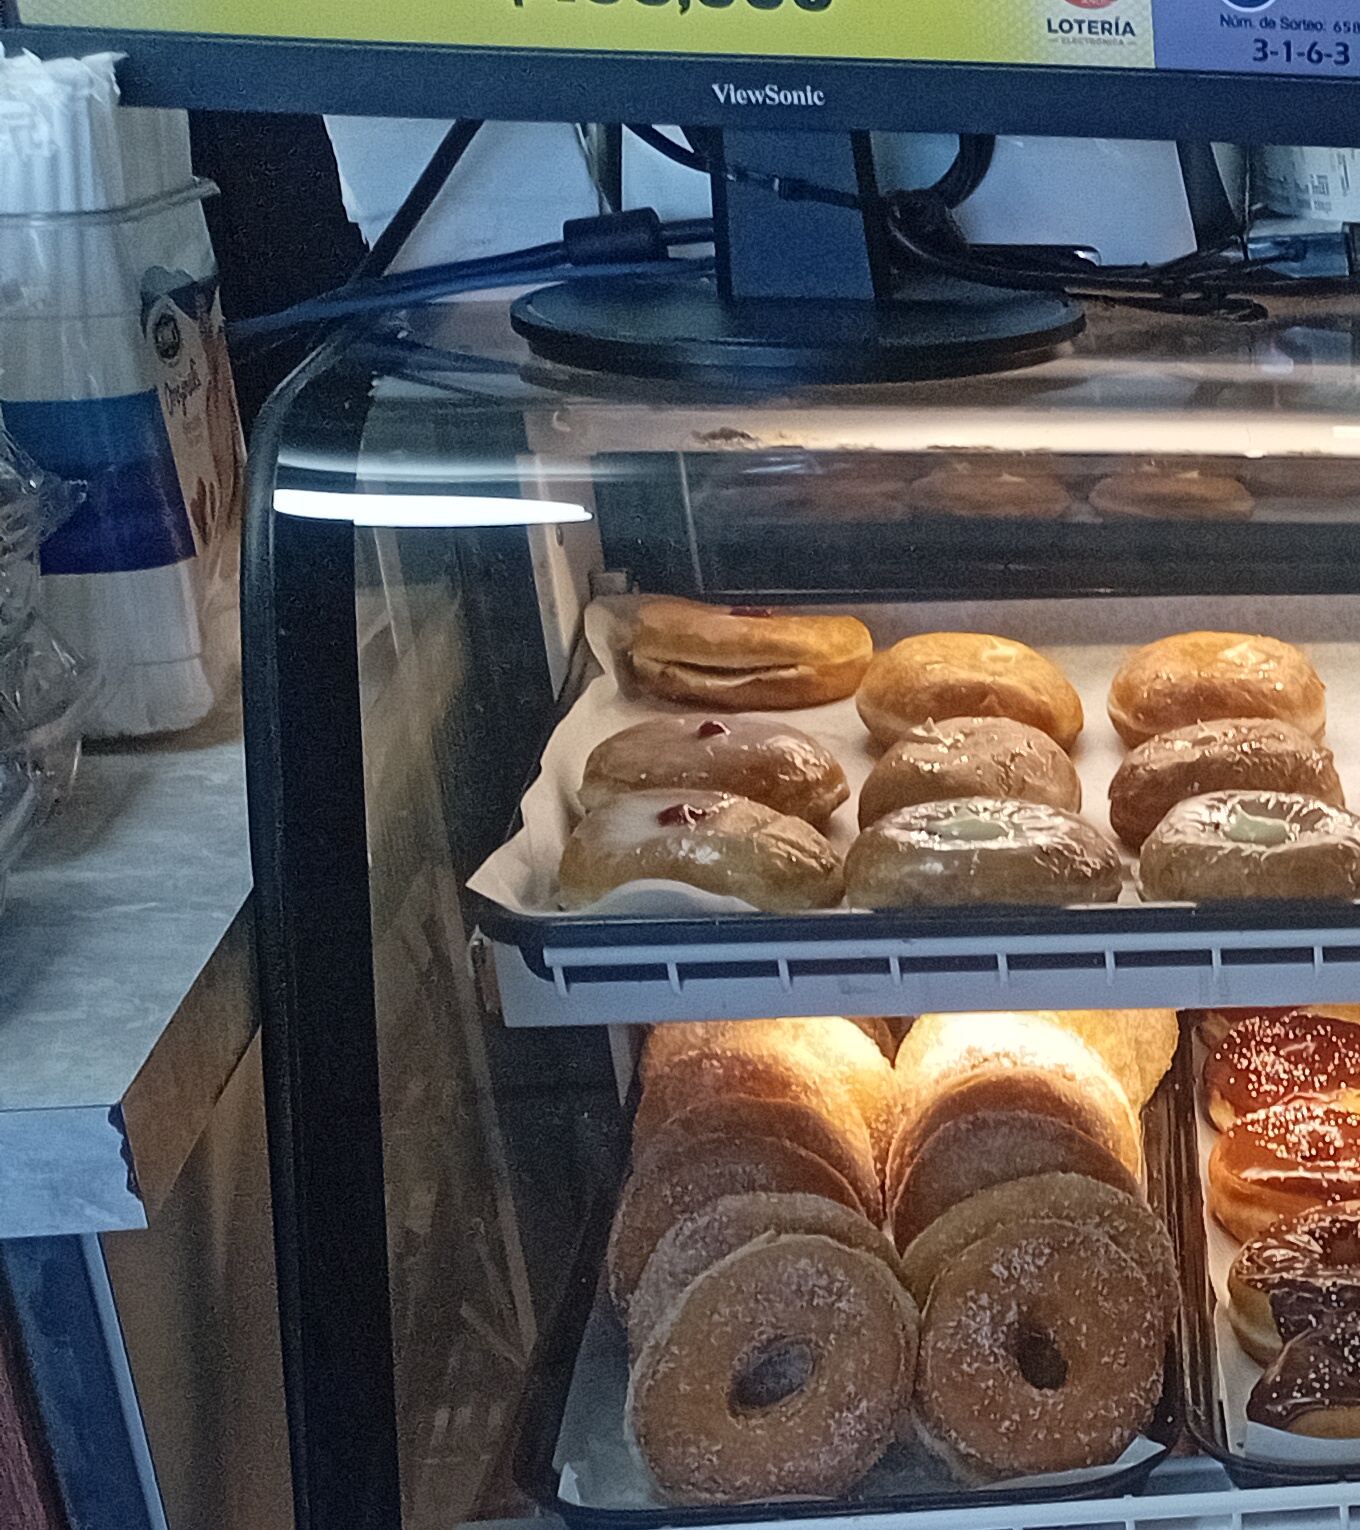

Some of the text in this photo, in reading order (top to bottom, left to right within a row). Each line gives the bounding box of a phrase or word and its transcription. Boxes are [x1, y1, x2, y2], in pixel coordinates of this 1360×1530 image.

[1046, 16, 1136, 37] LOTERÍA
[1259, 16, 1277, 29] de
[1252, 38, 1350, 66] 3-1-6-3
[711, 83, 825, 106] ViewSonic
